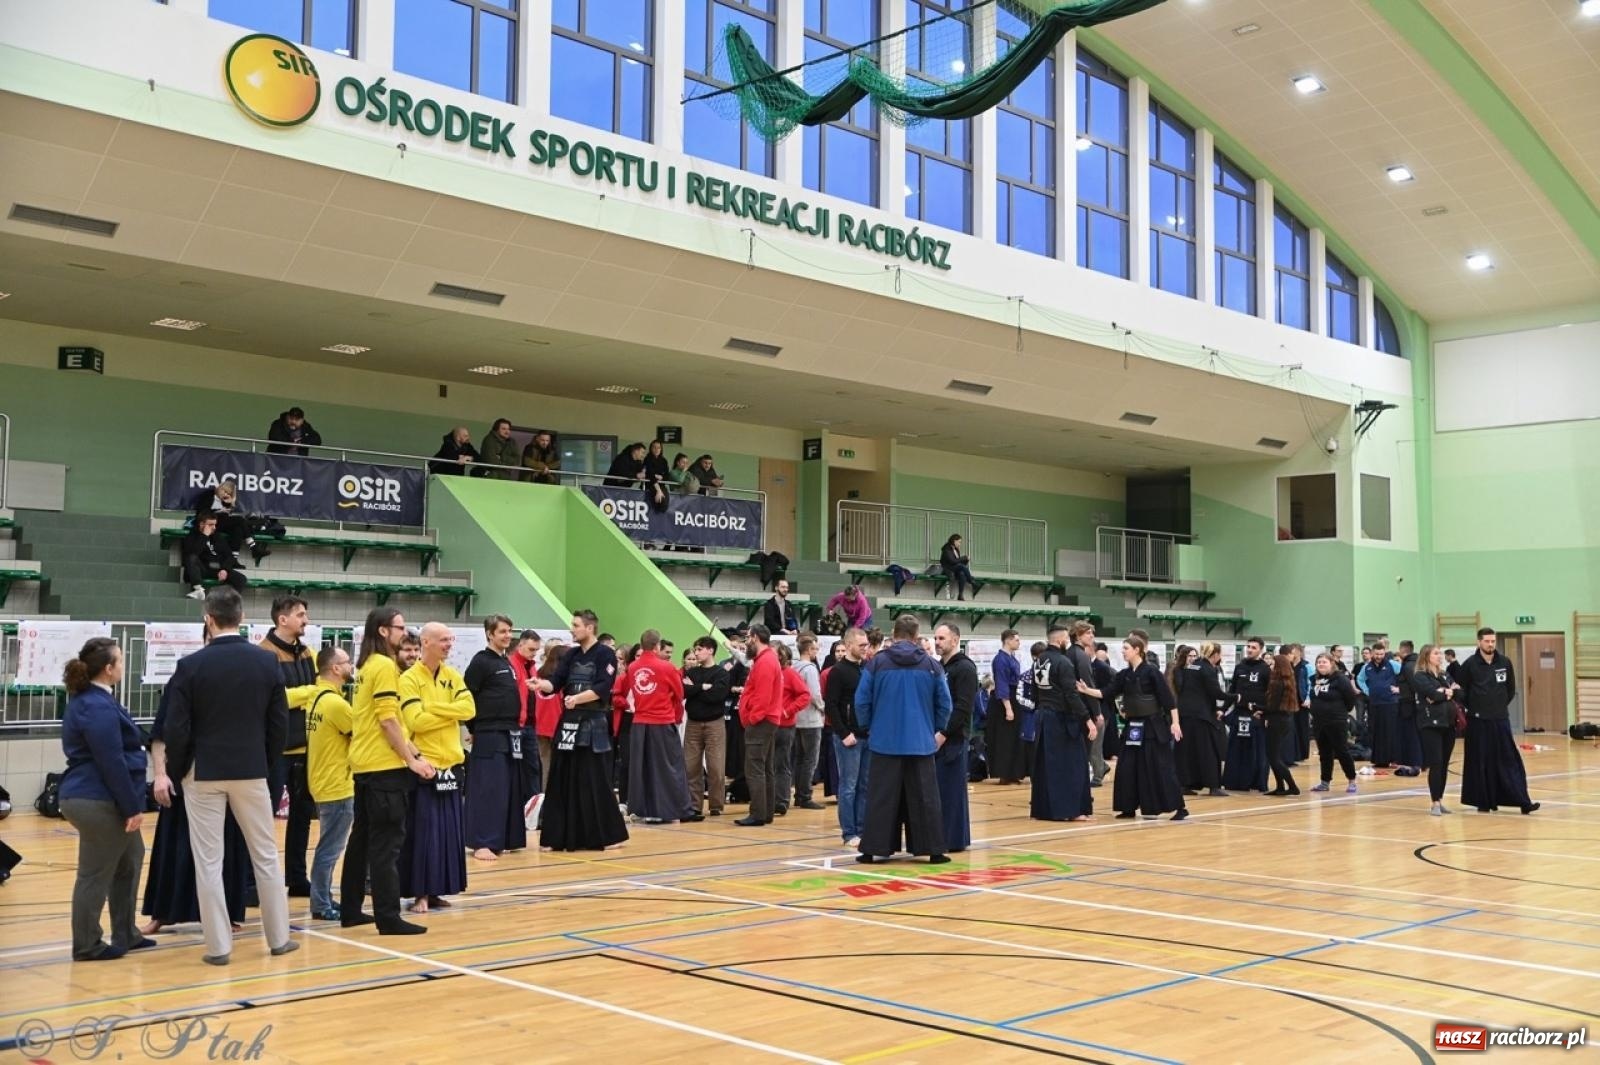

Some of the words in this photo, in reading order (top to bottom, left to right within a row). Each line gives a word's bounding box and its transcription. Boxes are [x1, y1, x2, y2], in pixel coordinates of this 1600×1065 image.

[335, 77, 516, 158] OŚRODEK
[529, 129, 658, 193] SPORTU
[667, 166, 676, 198] I
[686, 171, 830, 238] REKREACJI
[838, 213, 952, 271] RACIBÓRZ
[66, 354, 83, 368] E
[362, 501, 402, 512] RACIBÓRZ
[674, 511, 747, 531] RACIBÓRZ
